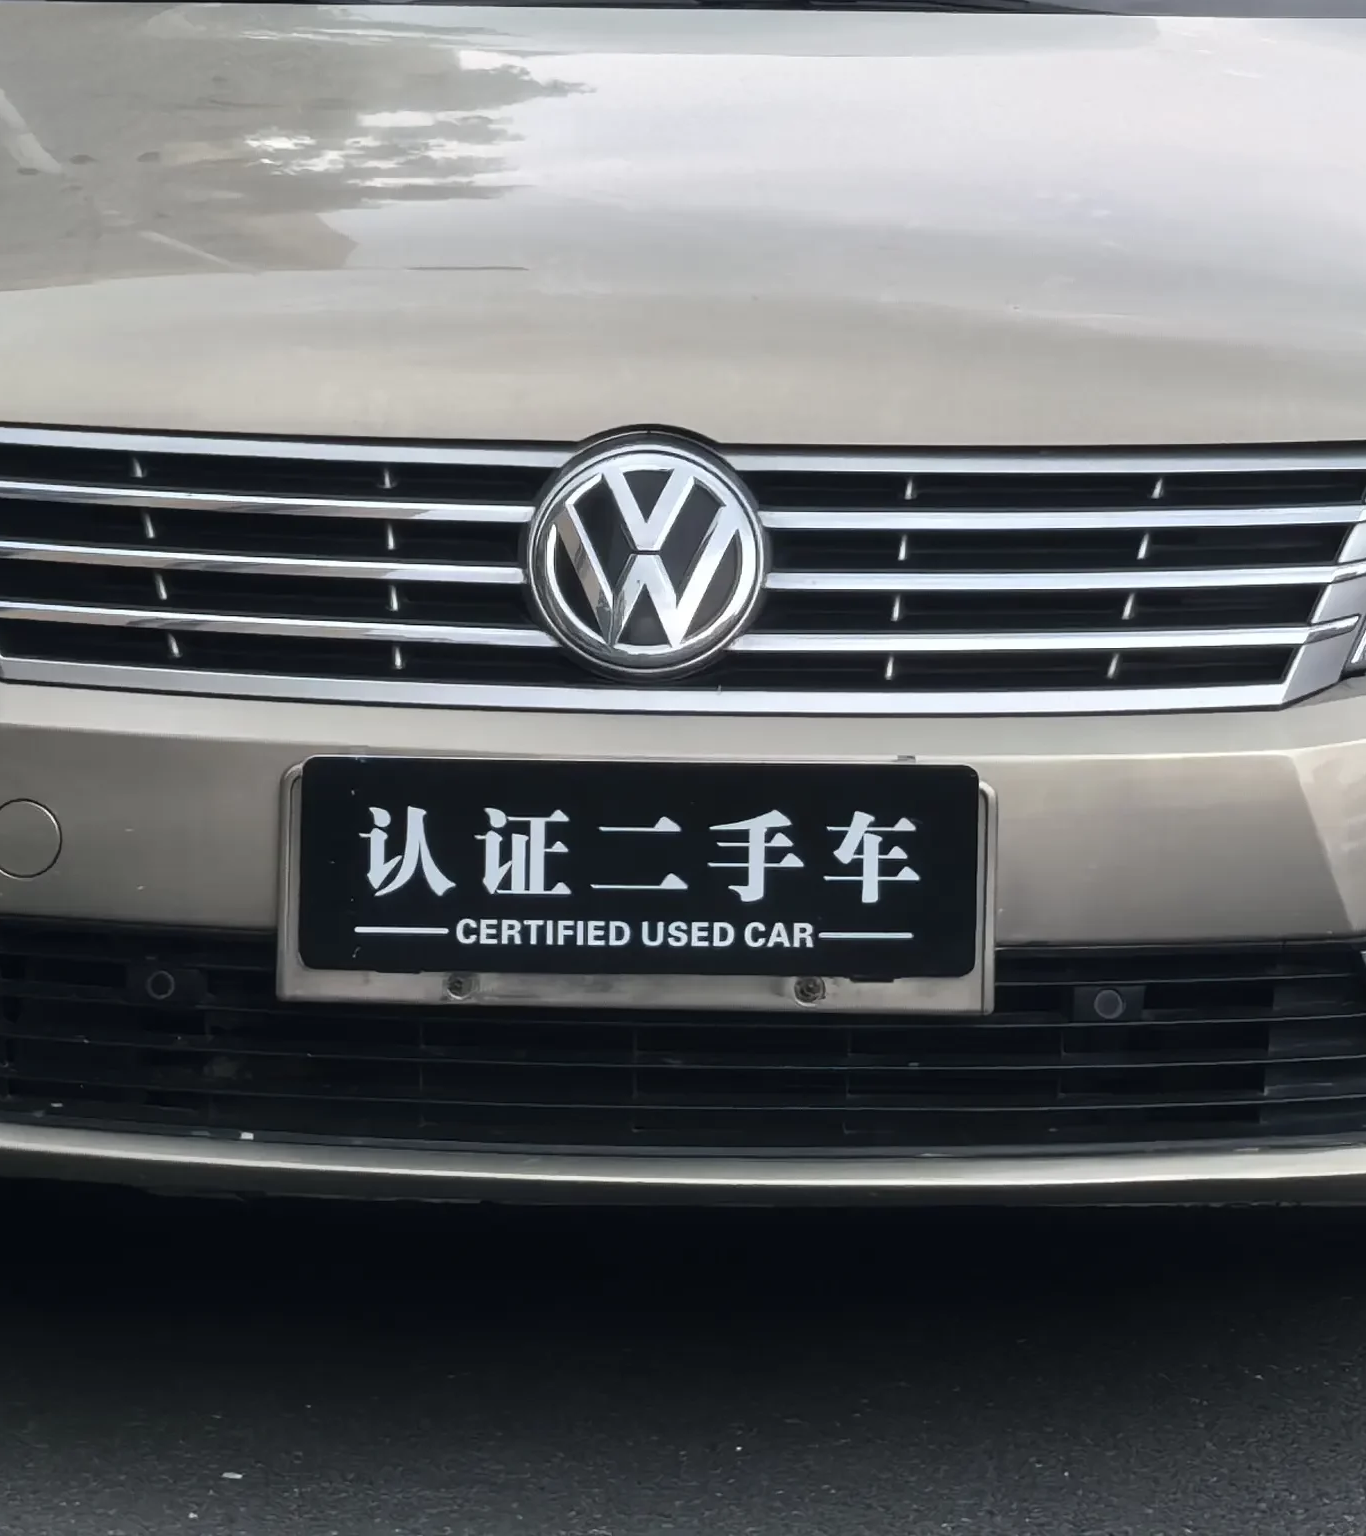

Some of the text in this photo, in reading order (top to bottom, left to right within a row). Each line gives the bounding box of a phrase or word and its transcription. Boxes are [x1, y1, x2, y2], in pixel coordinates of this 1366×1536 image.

[358, 805, 920, 904] 认证二手车
[455, 918, 814, 949] CERTIFIED USED CAR
